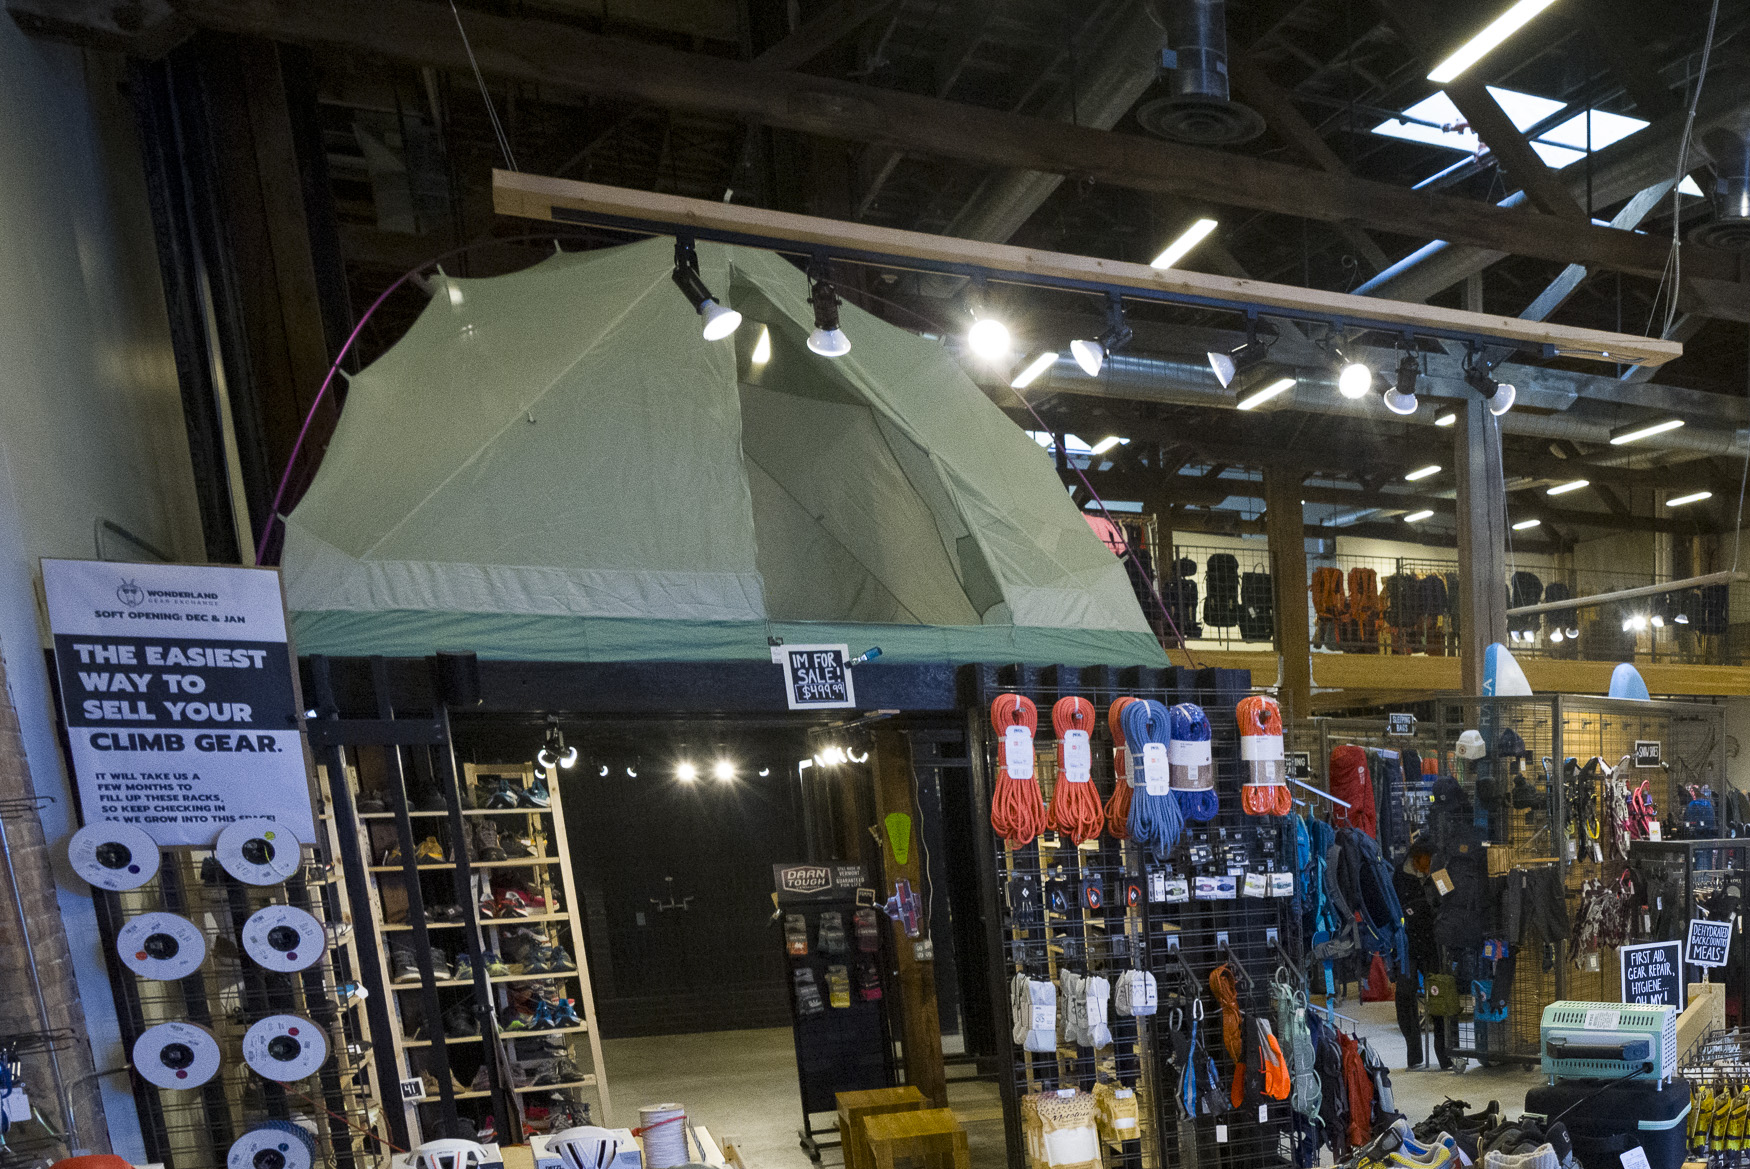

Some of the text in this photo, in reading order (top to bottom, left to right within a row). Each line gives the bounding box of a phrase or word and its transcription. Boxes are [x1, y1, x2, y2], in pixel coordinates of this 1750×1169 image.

[147, 590, 218, 600] WONDERLAND
[95, 610, 246, 624] SOFT OPENING: DEC & JAN
[73, 643, 267, 669] THE EASIEST
[813, 652, 837, 668] FOR
[797, 666, 841, 685] SALE!
[78, 671, 206, 695] WAY TO
[82, 700, 253, 722] SELL YOUR
[1396, 724, 1409, 732] BAGS
[89, 732, 283, 753] CLIMB GEAR.
[95, 772, 201, 781] IT WILL TAKE US A
[97, 783, 193, 792] FEW MONTHS TO
[99, 794, 123, 802] FILL
[125, 794, 141, 802] UP
[145, 794, 180, 802] THESE
[101, 804, 226, 813] SO KEEP CHECKING IN
[123, 815, 142, 823] WE
[144, 815, 178, 823] GROW
[181, 815, 209, 823] INTO
[210, 814, 236, 823] THIS
[788, 869, 826, 880] DARN
[787, 878, 826, 887] TOUGH
[1693, 924, 1729, 938] DEHYDRATED
[1630, 949, 1666, 965] FIRST AID,
[1693, 945, 1720, 961] MEALS
[1627, 963, 1676, 980] GEAR REPAIR,
[1635, 995, 1648, 1004] OH
[404, 1085, 416, 1095] 41
